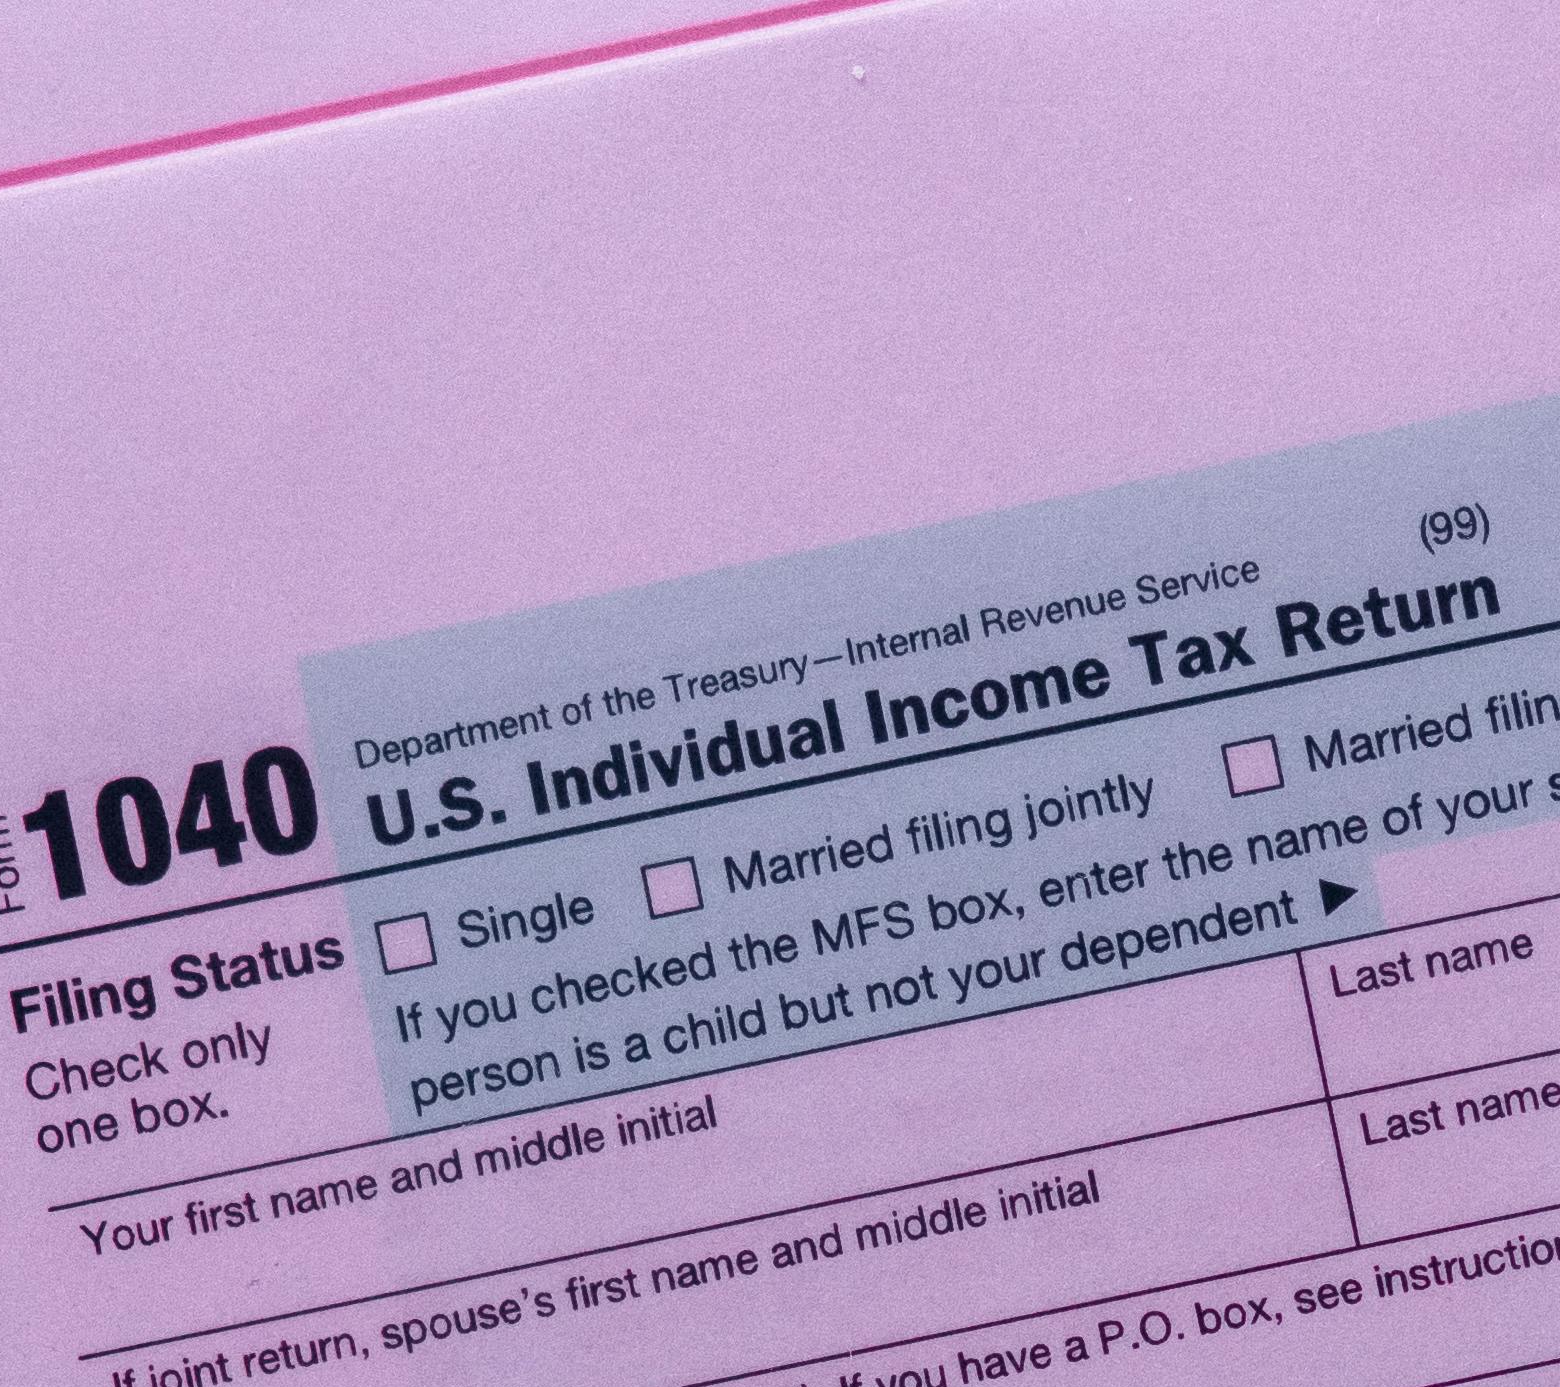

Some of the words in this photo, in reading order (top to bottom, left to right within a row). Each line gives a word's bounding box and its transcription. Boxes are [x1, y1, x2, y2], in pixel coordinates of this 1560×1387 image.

[1418, 501, 1491, 555] (99)
[353, 703, 553, 770] Department
[560, 692, 593, 727] of
[600, 685, 656, 717] the
[978, 587, 1127, 638] Revenue
[1134, 559, 1261, 605] Service
[365, 775, 507, 847] U.S.
[526, 698, 845, 816] Individual
[864, 657, 1111, 744] Income
[1127, 626, 1255, 686] Tax
[1275, 575, 1501, 658] Return
[1303, 702, 1473, 773] Married
[22, 745, 319, 901] 1040
[722, 823, 895, 894] Married
[904, 807, 1014, 855] filing
[1023, 773, 1154, 841] jointly
[456, 891, 595, 950] Single
[1328, 950, 1416, 999] Last
[1424, 932, 1535, 979] name
[8, 974, 157, 1035] Filing
[169, 935, 345, 1000] Status
[23, 1040, 169, 1101] Check
[181, 1021, 272, 1070] only
[35, 1112, 120, 1155] one
[130, 1091, 230, 1135] box.
[79, 1214, 174, 1257] Your
[183, 1191, 260, 1237] first
[269, 1173, 378, 1219] name
[390, 1147, 464, 1195] and
[473, 1122, 606, 1177] middle
[615, 1093, 719, 1148] initial
